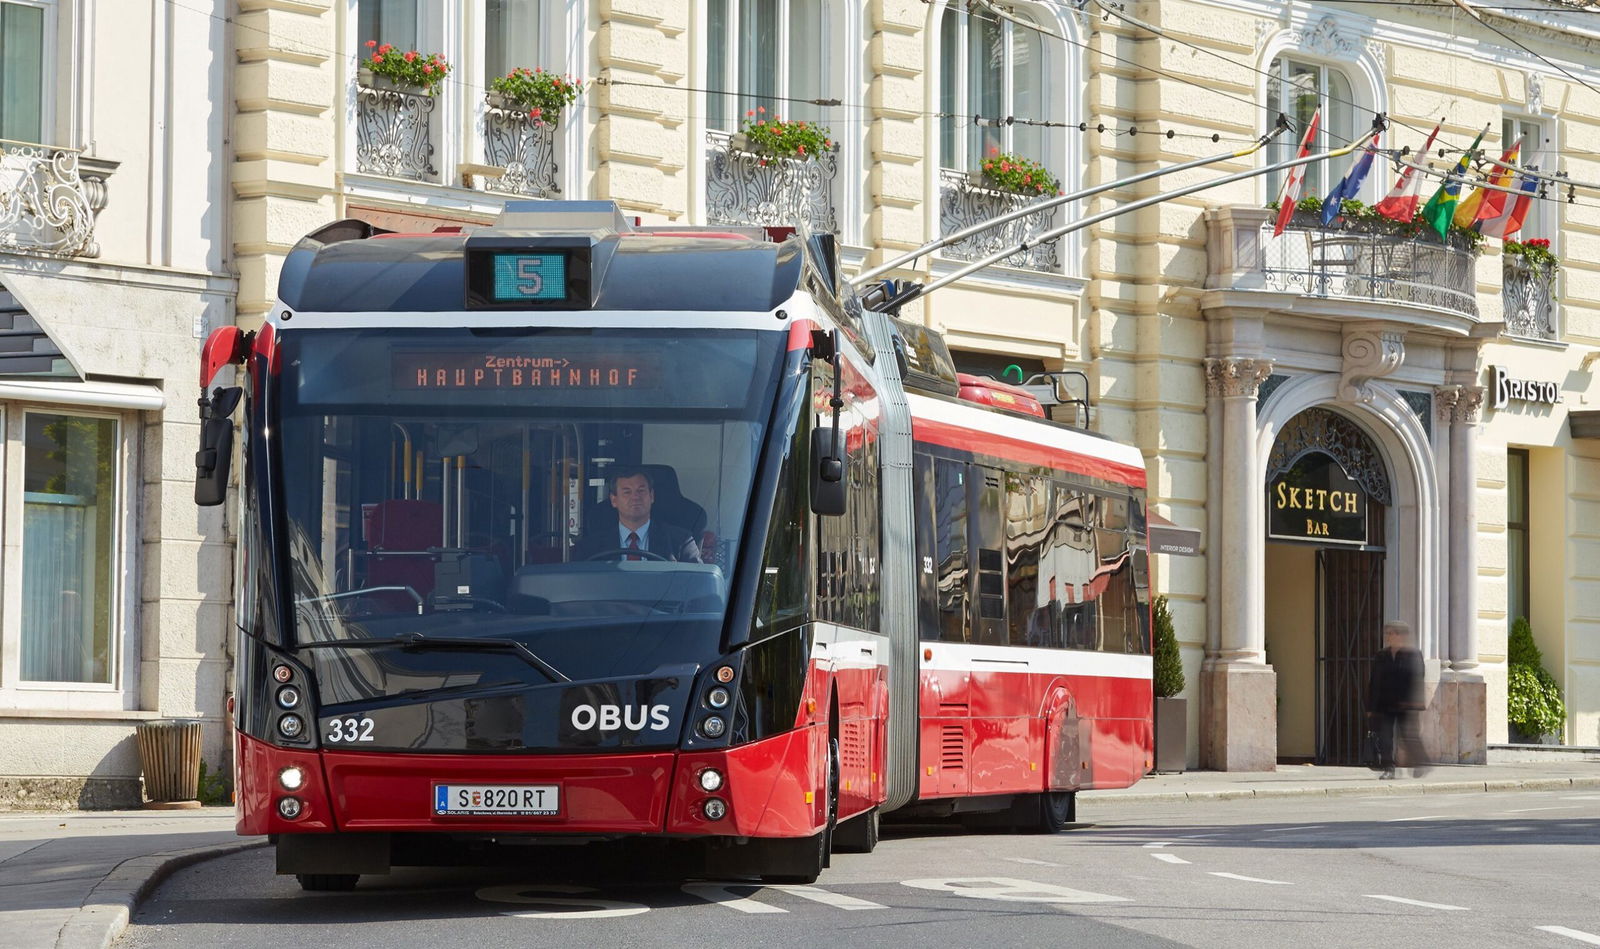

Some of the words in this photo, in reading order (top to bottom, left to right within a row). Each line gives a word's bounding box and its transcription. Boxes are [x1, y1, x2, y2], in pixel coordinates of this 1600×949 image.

[517, 258, 543, 295] 5
[417, 369, 638, 386] HAUPTBAHNHOF
[1490, 365, 1563, 409] BRISTOL
[1277, 482, 1357, 513] SKETCH
[1306, 519, 1330, 536] BAR
[1160, 544, 1178, 552] INTERIOR
[570, 704, 670, 731] OBUS
[328, 718, 374, 742] 332
[458, 789, 469, 808] S
[484, 789, 518, 808] 820
[523, 789, 546, 808] RT
